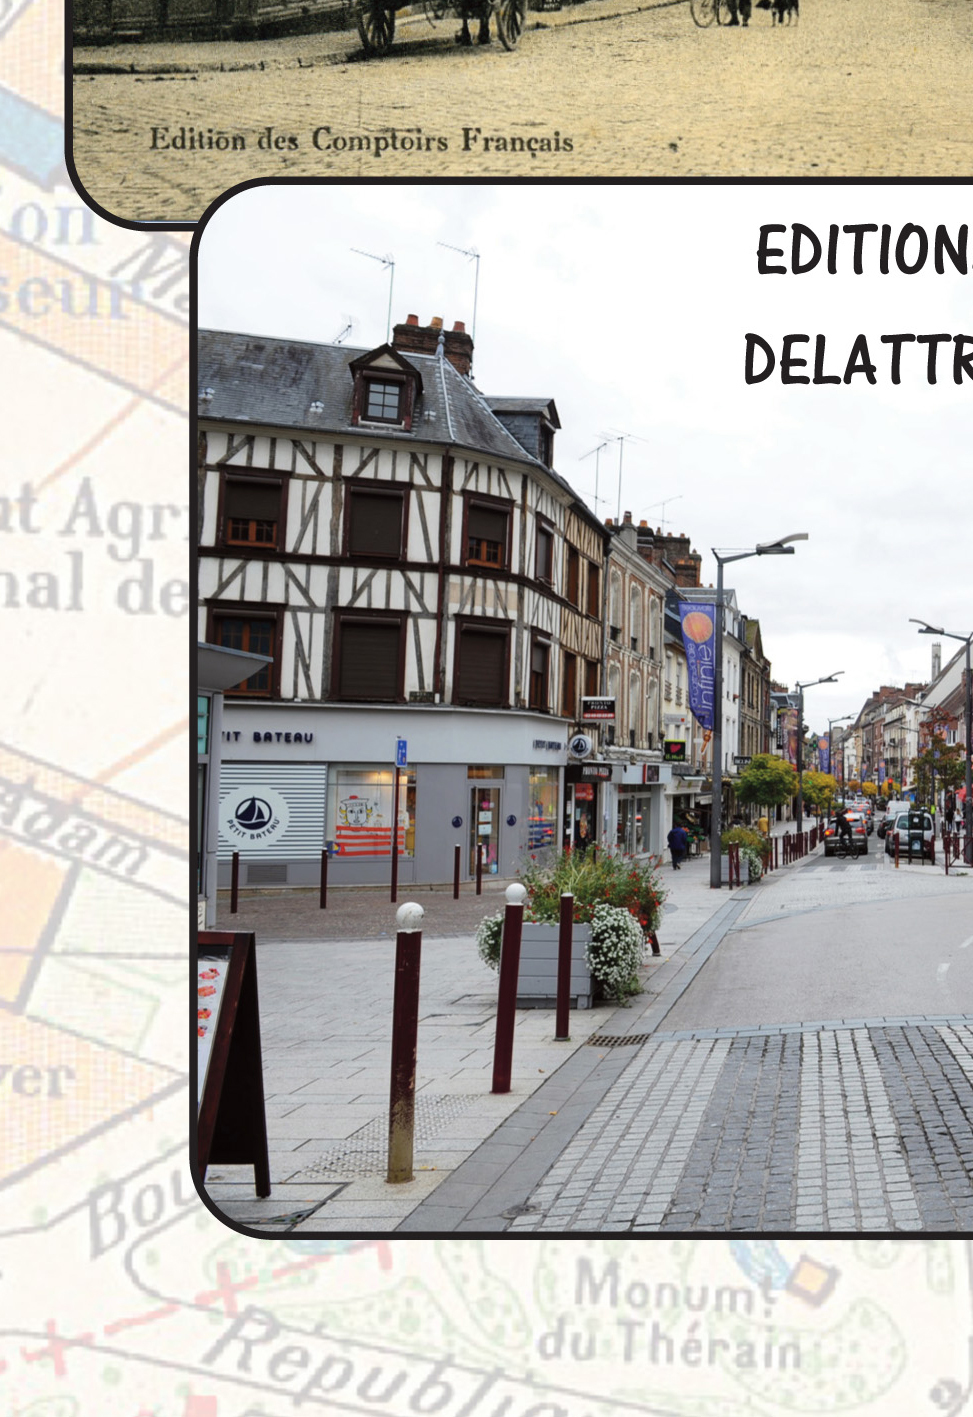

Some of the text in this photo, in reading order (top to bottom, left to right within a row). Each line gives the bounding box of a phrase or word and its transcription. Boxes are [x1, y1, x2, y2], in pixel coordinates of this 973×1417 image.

[253, 731, 314, 744] BATEAU
[226, 816, 281, 840] PETIT BATEAU
[616, 1316, 804, 1372] Thérain
